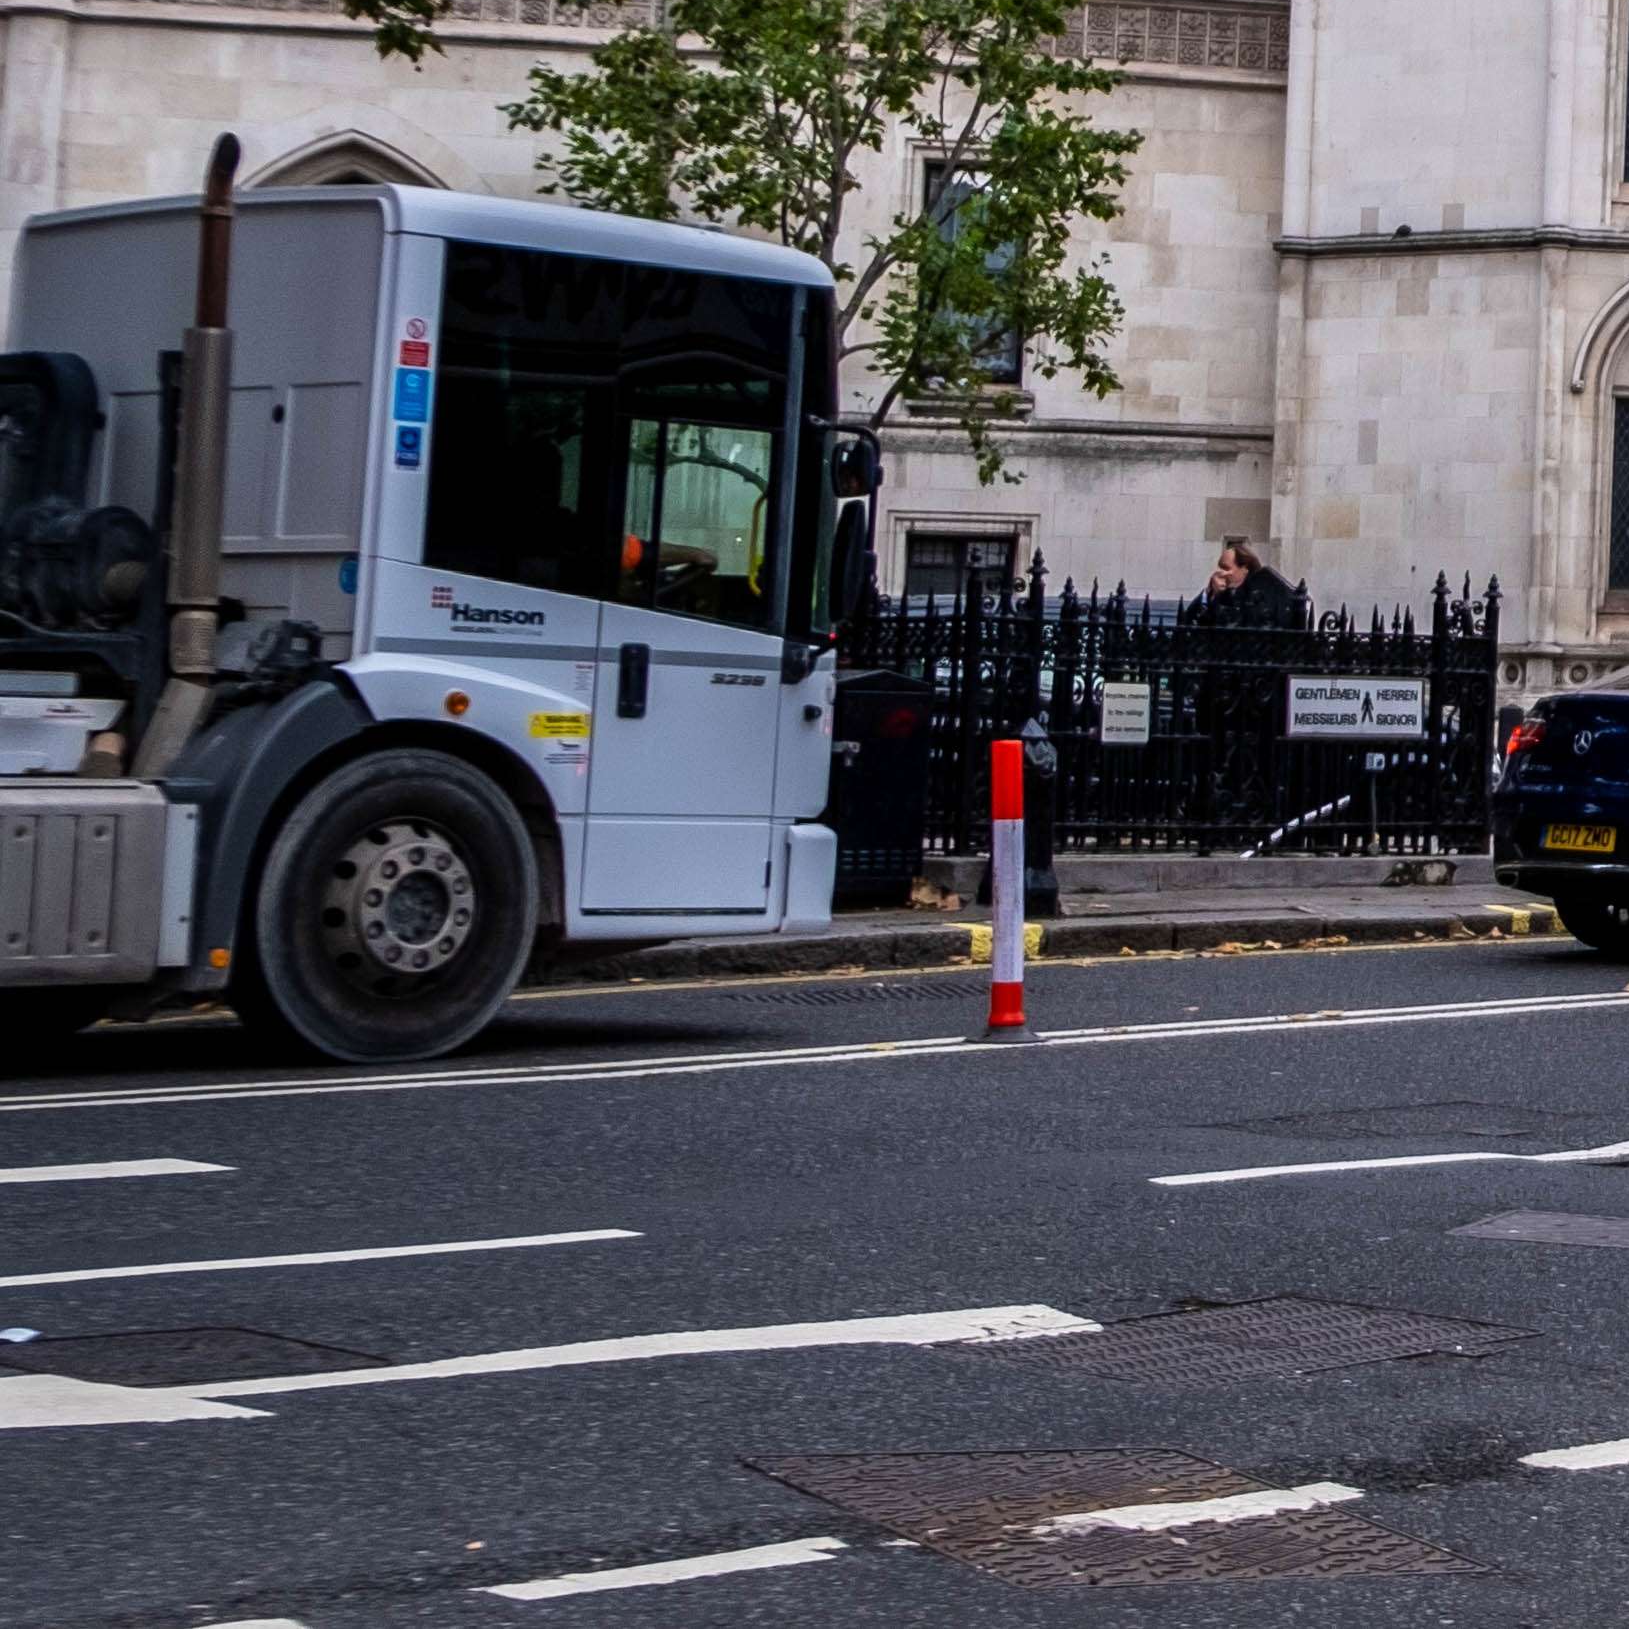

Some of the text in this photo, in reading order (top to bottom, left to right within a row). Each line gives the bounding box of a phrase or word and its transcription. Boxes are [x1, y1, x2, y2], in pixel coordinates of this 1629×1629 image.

[451, 602, 545, 626] Hanson
[1295, 687, 1418, 701] GENTLEMEN HERREN
[1294, 712, 1417, 727] MESSIEURS SIGNORI
